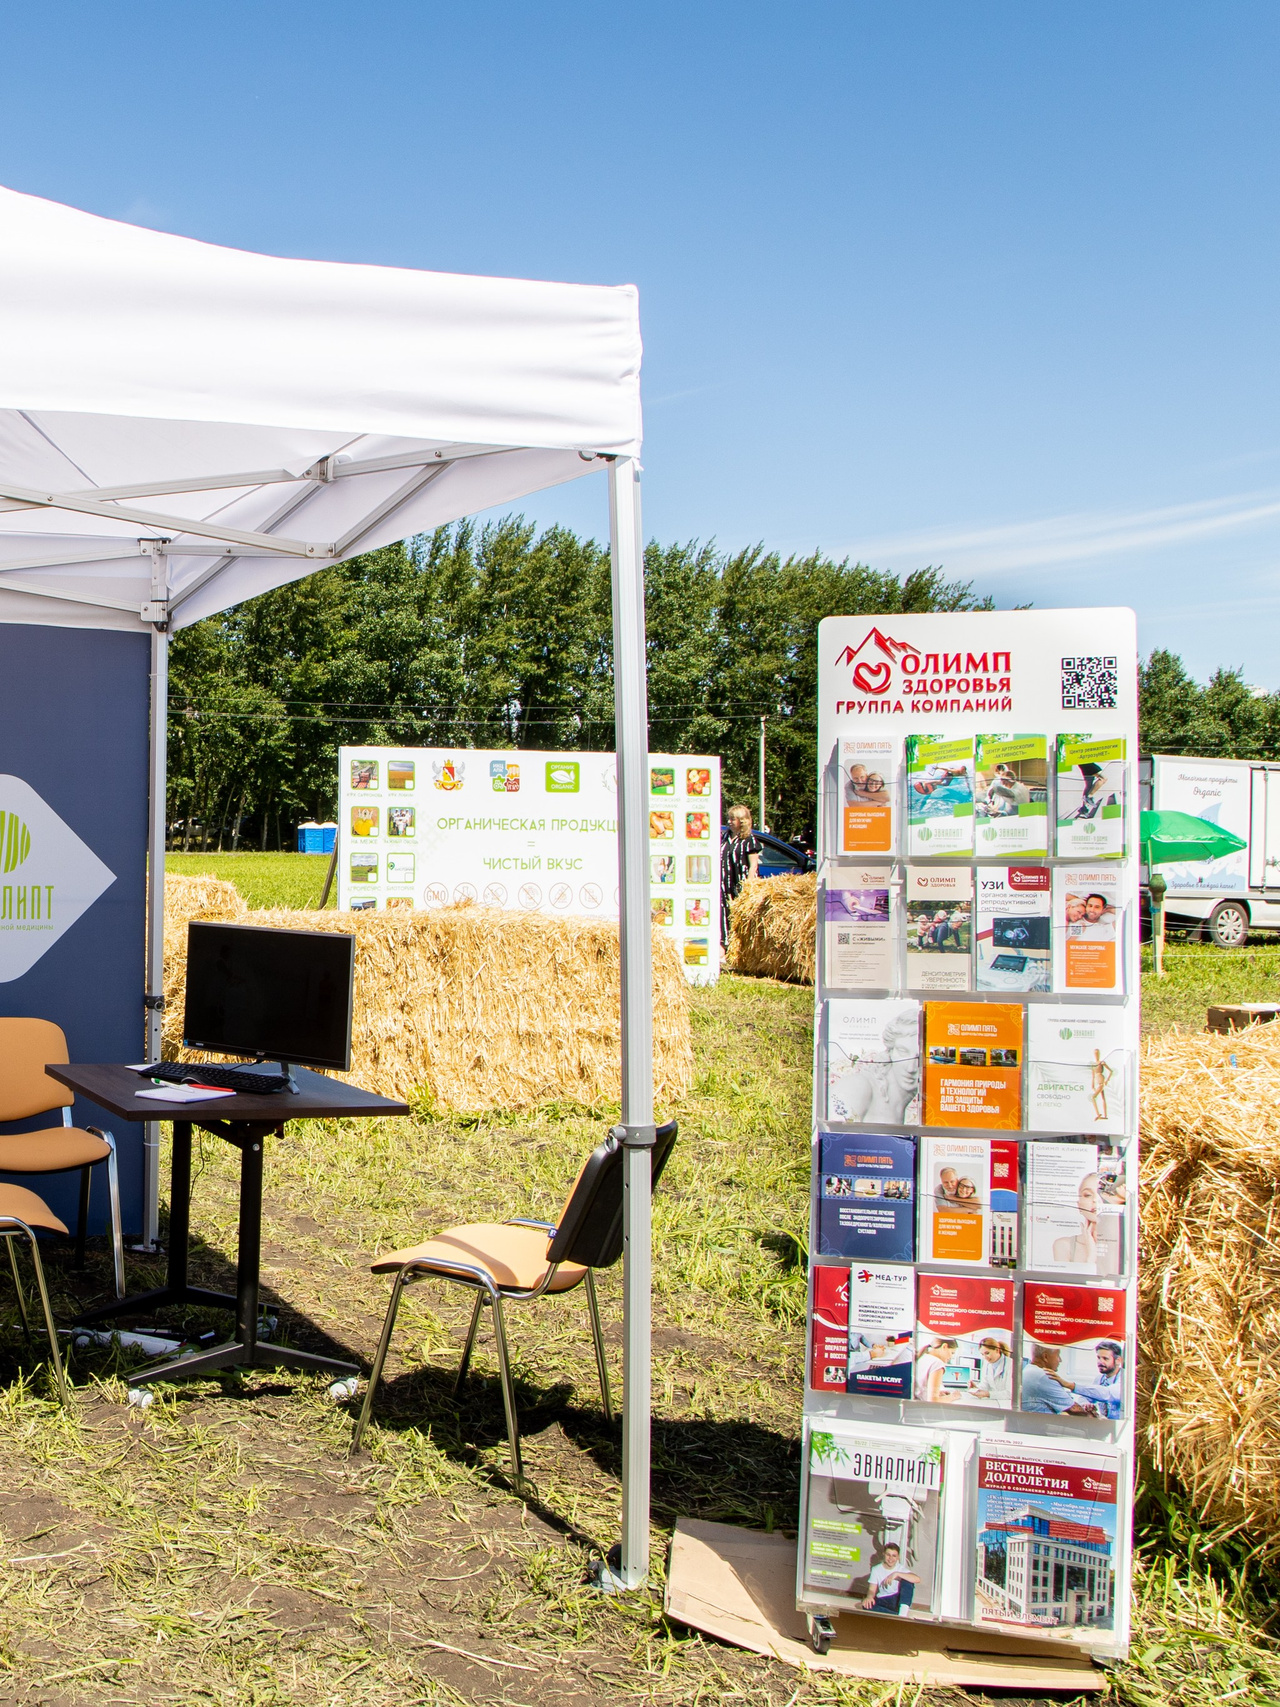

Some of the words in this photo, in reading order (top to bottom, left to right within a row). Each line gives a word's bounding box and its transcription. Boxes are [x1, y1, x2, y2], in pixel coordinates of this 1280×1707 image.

[901, 652, 1012, 674] ОЛИМП
[902, 678, 1011, 696] ЗДОРОВЬЯ
[836, 700, 904, 714] ГРУППА
[911, 696, 1012, 714] КОМПАНИЙ
[878, 742, 892, 750] ПЯТЬ
[1192, 786, 1222, 798] Organic
[436, 818, 546, 831] ОРГАНИЧЕСКАЯ
[551, 818, 618, 832] ПРОДУКЦ
[483, 856, 542, 870] ЧИСТЫЙ
[547, 858, 583, 870] ВКУС
[981, 881, 1004, 890] УЗИ
[16, 923, 54, 932] медицины
[843, 1016, 877, 1024] ОЛИМП
[961, 1024, 982, 1032] ОЛИМП
[940, 1078, 974, 1087] ГАРМОНИЯ
[975, 1080, 1006, 1089] ПРИРОДЫ
[940, 1096, 954, 1104] ДЛЯ
[955, 1096, 983, 1104] ЗАЩИТЫ
[940, 1104, 966, 1112] ВАШЕГО
[967, 1105, 1000, 1114] ЗДОРОВЬЯ
[947, 1144, 968, 1152] ОЛИМП
[969, 1146, 984, 1154] ПЯТЬ
[857, 1156, 877, 1164] ОЛИМП
[875, 1274, 907, 1282] МЕД-ТУР
[857, 1374, 882, 1382] ПАКЕТЫ
[854, 1453, 936, 1485] ЭВКАЛИПТ
[985, 1460, 1044, 1476] ВЕСТНИК
[984, 1472, 1069, 1490] ДОЛГОЛЕТИЯ
[982, 1608, 1012, 1617] ПЯТЫЙ
